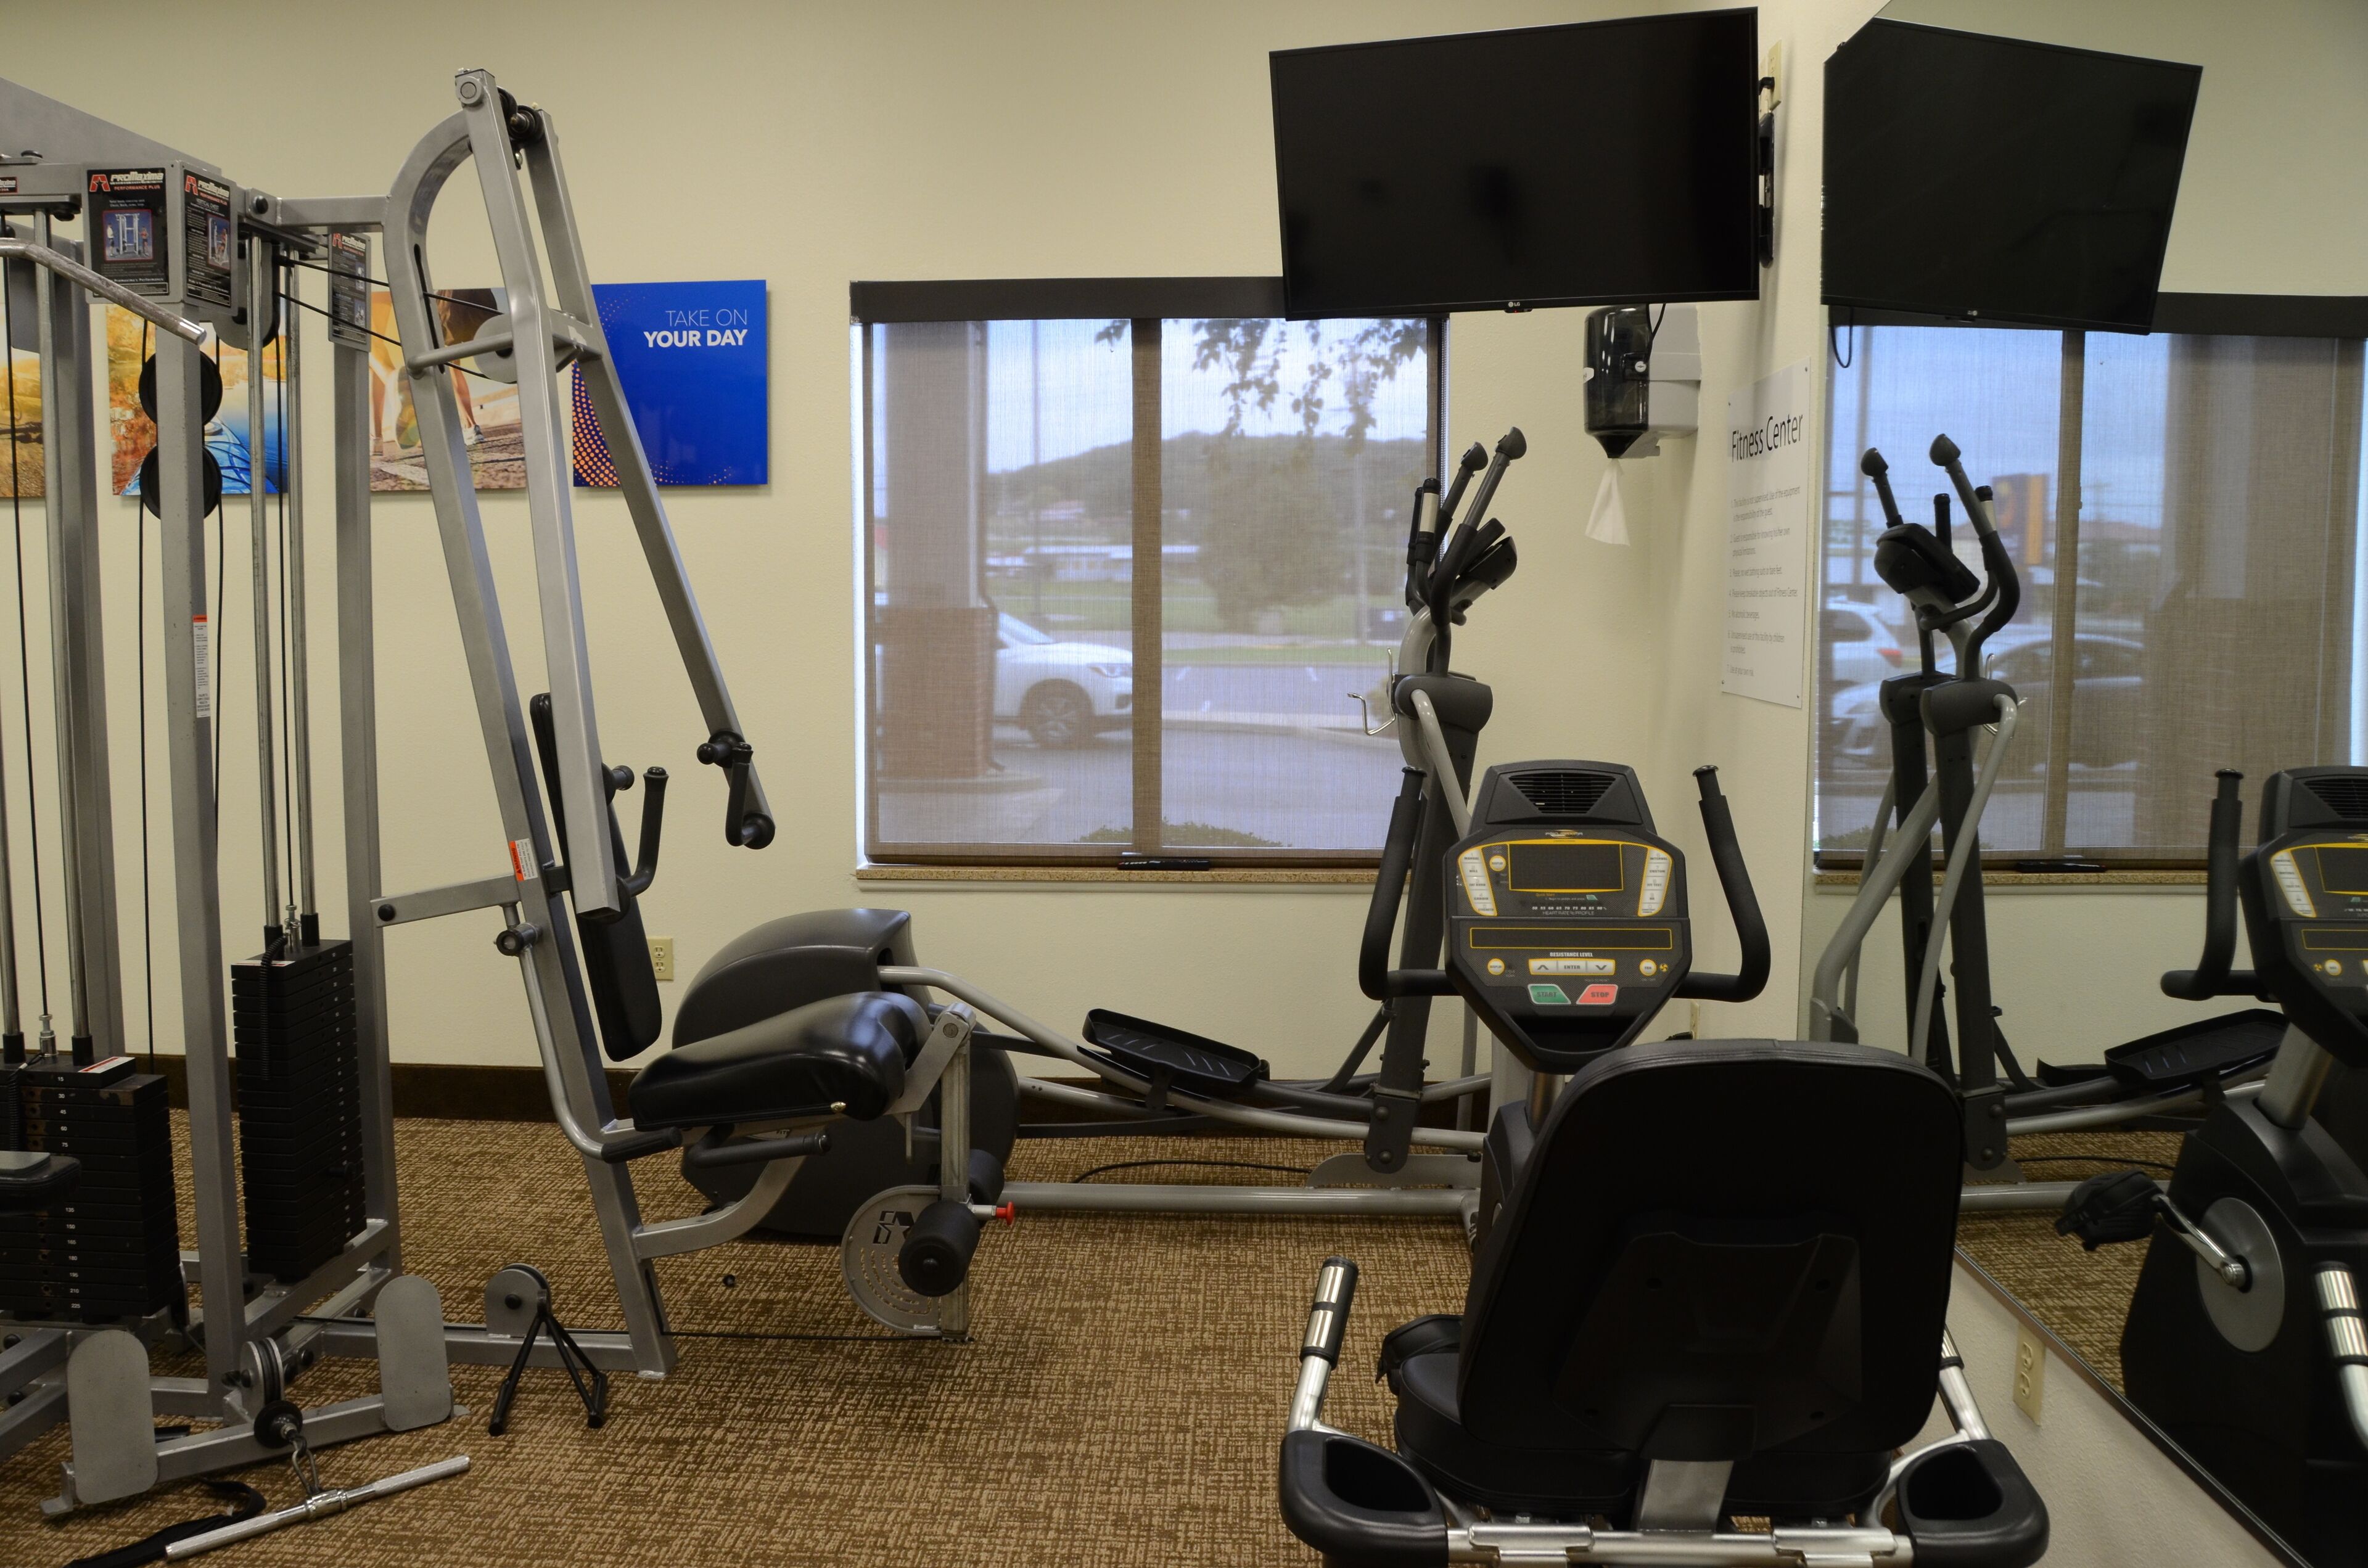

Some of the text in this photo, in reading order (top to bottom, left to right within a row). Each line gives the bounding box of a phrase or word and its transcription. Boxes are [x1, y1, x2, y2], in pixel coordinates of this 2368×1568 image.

[665, 308, 748, 327] TAKE ON
[643, 329, 748, 348] YOUR DAY
[1732, 414, 1803, 462] Fitness Center
